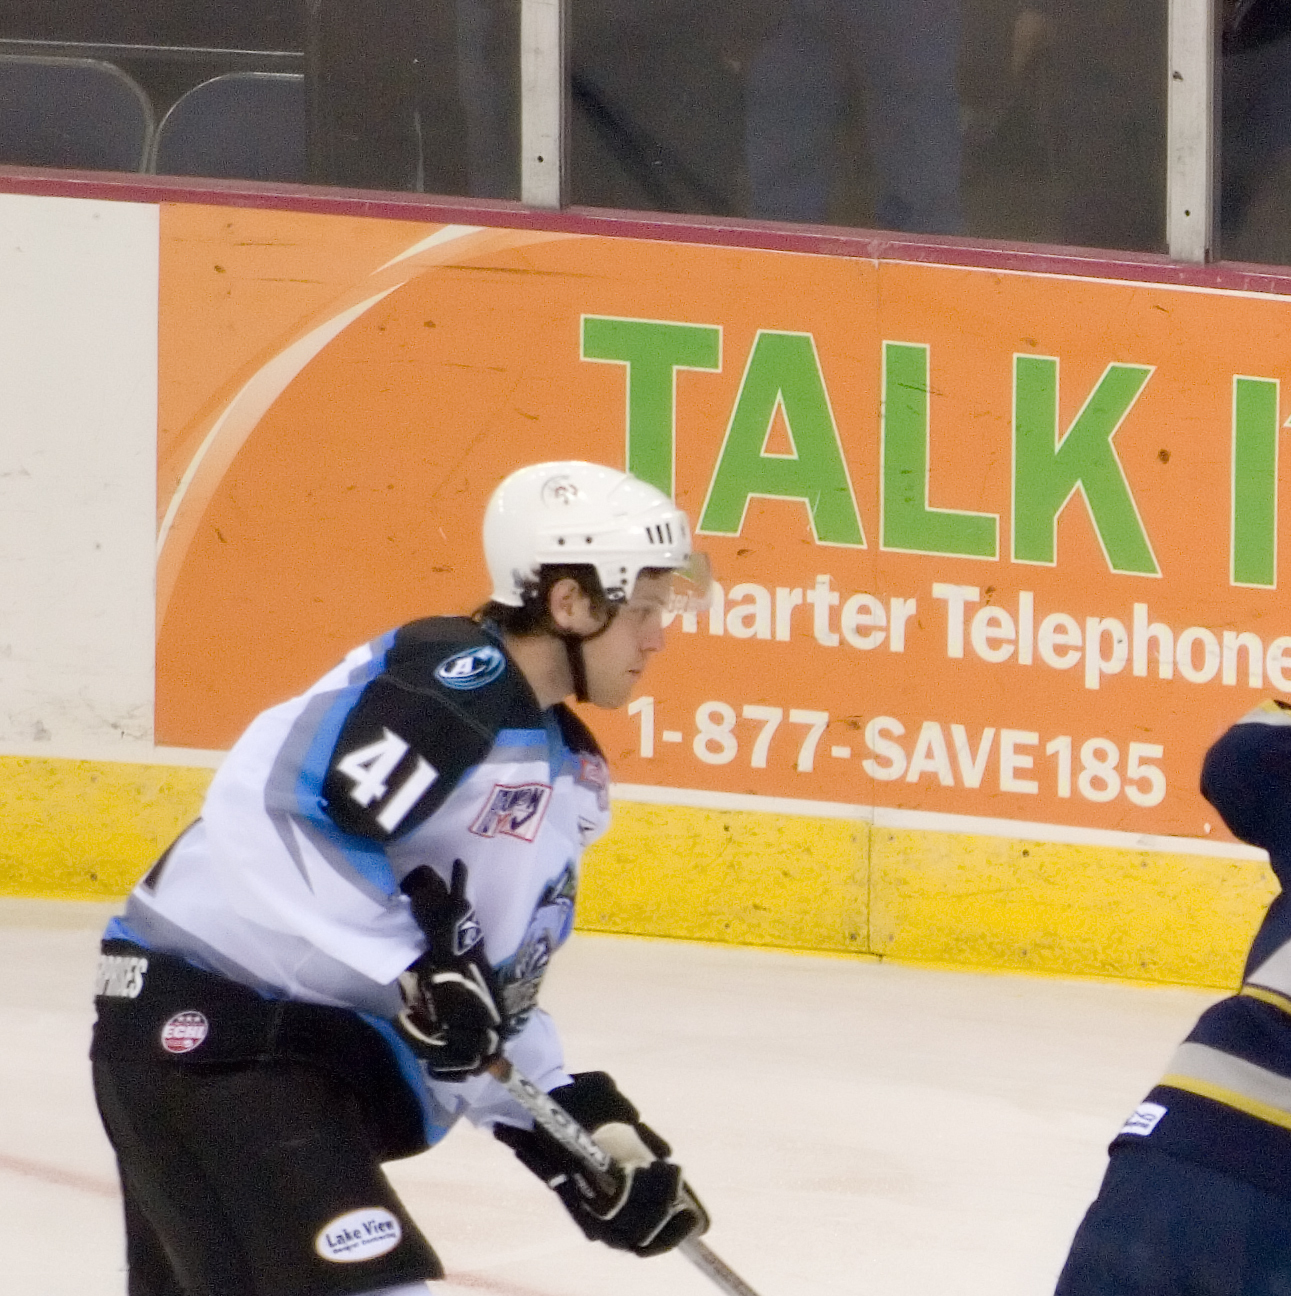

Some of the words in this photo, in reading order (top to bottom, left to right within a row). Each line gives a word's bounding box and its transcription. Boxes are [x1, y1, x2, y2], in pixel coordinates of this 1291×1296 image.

[580, 314, 1163, 578] TALK
[660, 575, 917, 654] harter
[336, 726, 440, 835] 41
[326, 1230, 362, 1248] Lake
[362, 1219, 394, 1236] View
